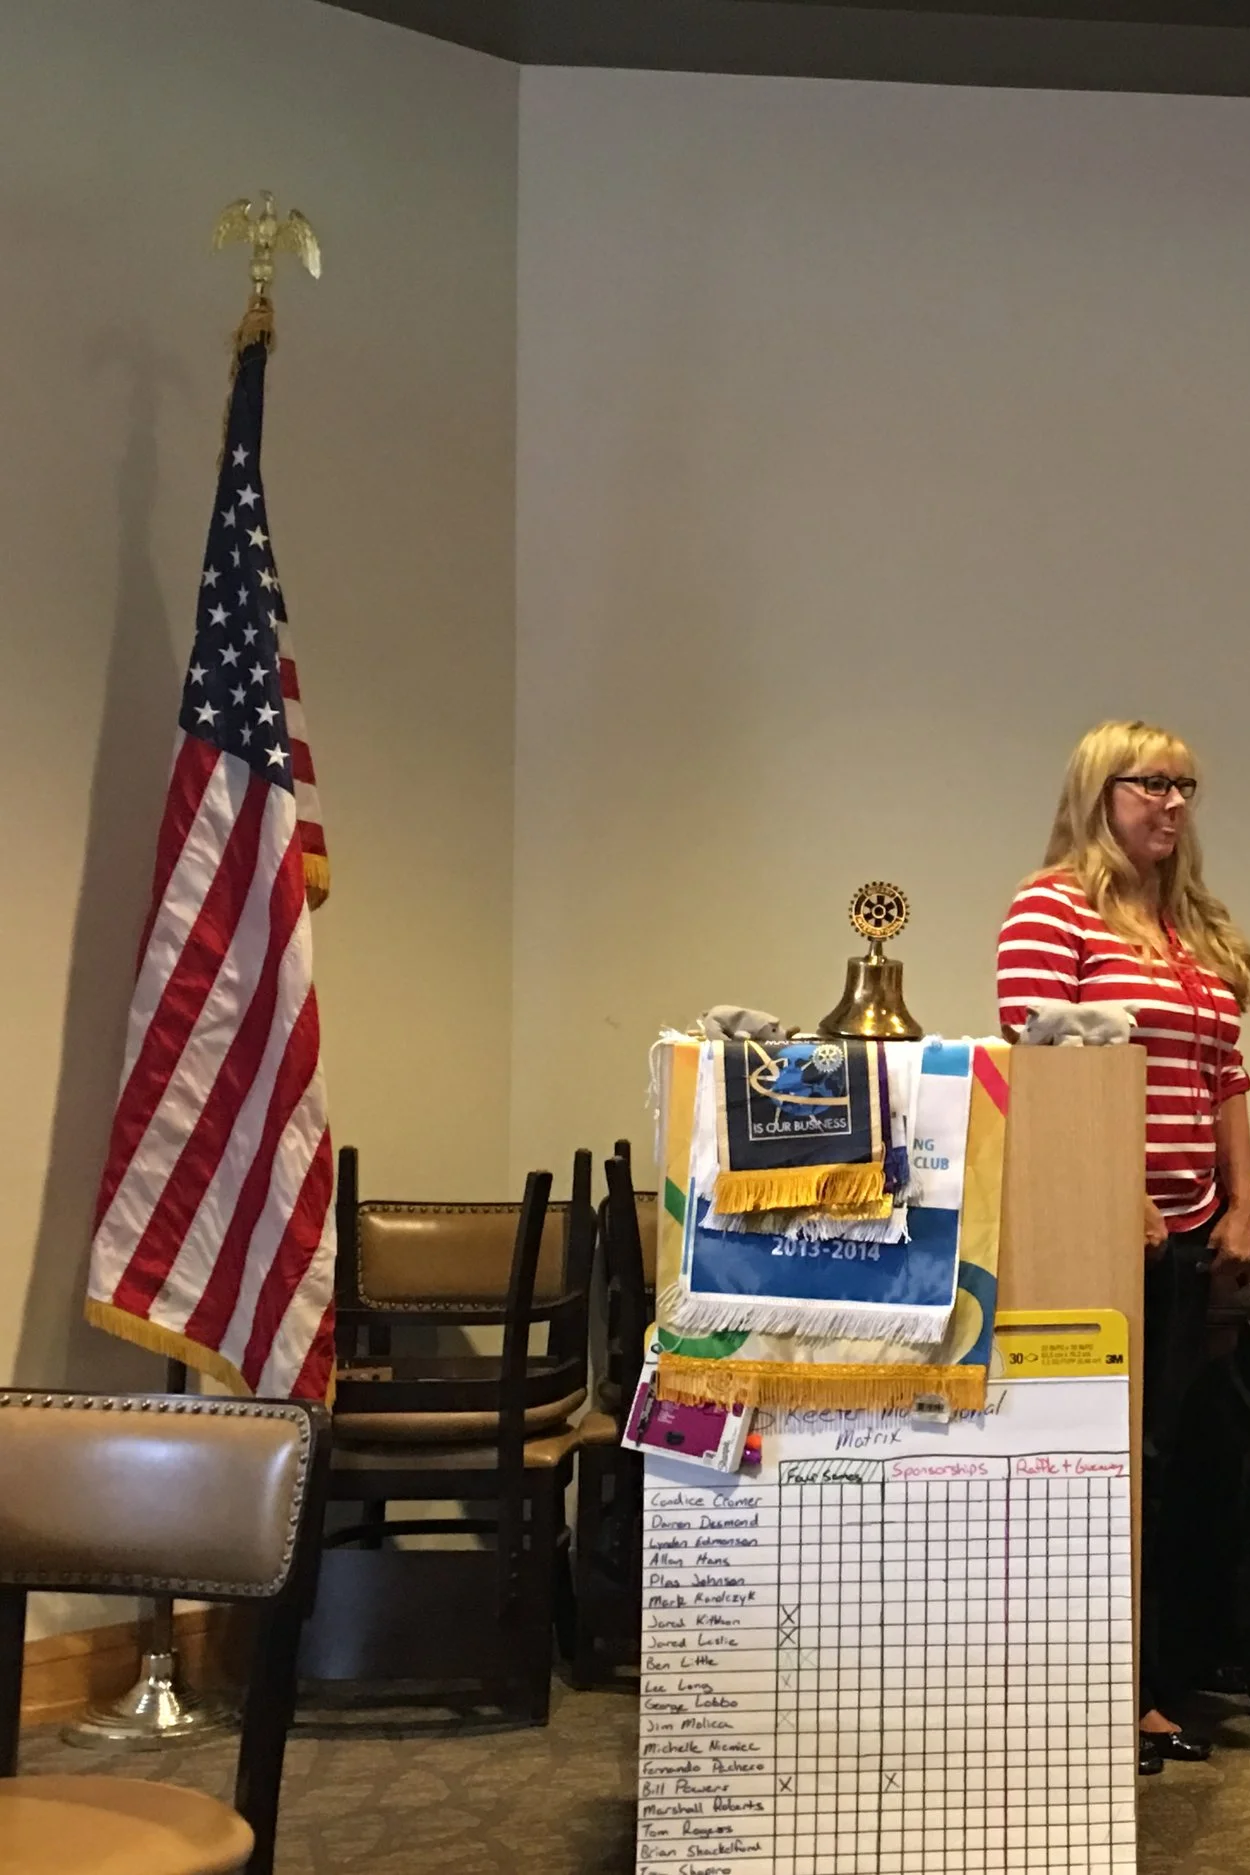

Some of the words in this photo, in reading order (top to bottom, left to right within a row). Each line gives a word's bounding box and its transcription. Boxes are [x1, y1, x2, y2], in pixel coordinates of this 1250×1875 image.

[754, 1122, 763, 1134] IS
[766, 1119, 791, 1134] OUR
[794, 1117, 847, 1132] BUSINESS
[914, 1155, 949, 1170] CLUB
[771, 1236, 881, 1261] 2013-2014
[1009, 1352, 1024, 1365] 30
[1105, 1354, 1123, 1364] 3M
[836, 1427, 902, 1450] Matrix
[892, 1463, 989, 1482] Sponsorships
[646, 1657, 670, 1670] Ben
[647, 1719, 674, 1732] Jim
[642, 1781, 665, 1798] Bill
[642, 1823, 669, 1838] Tom
